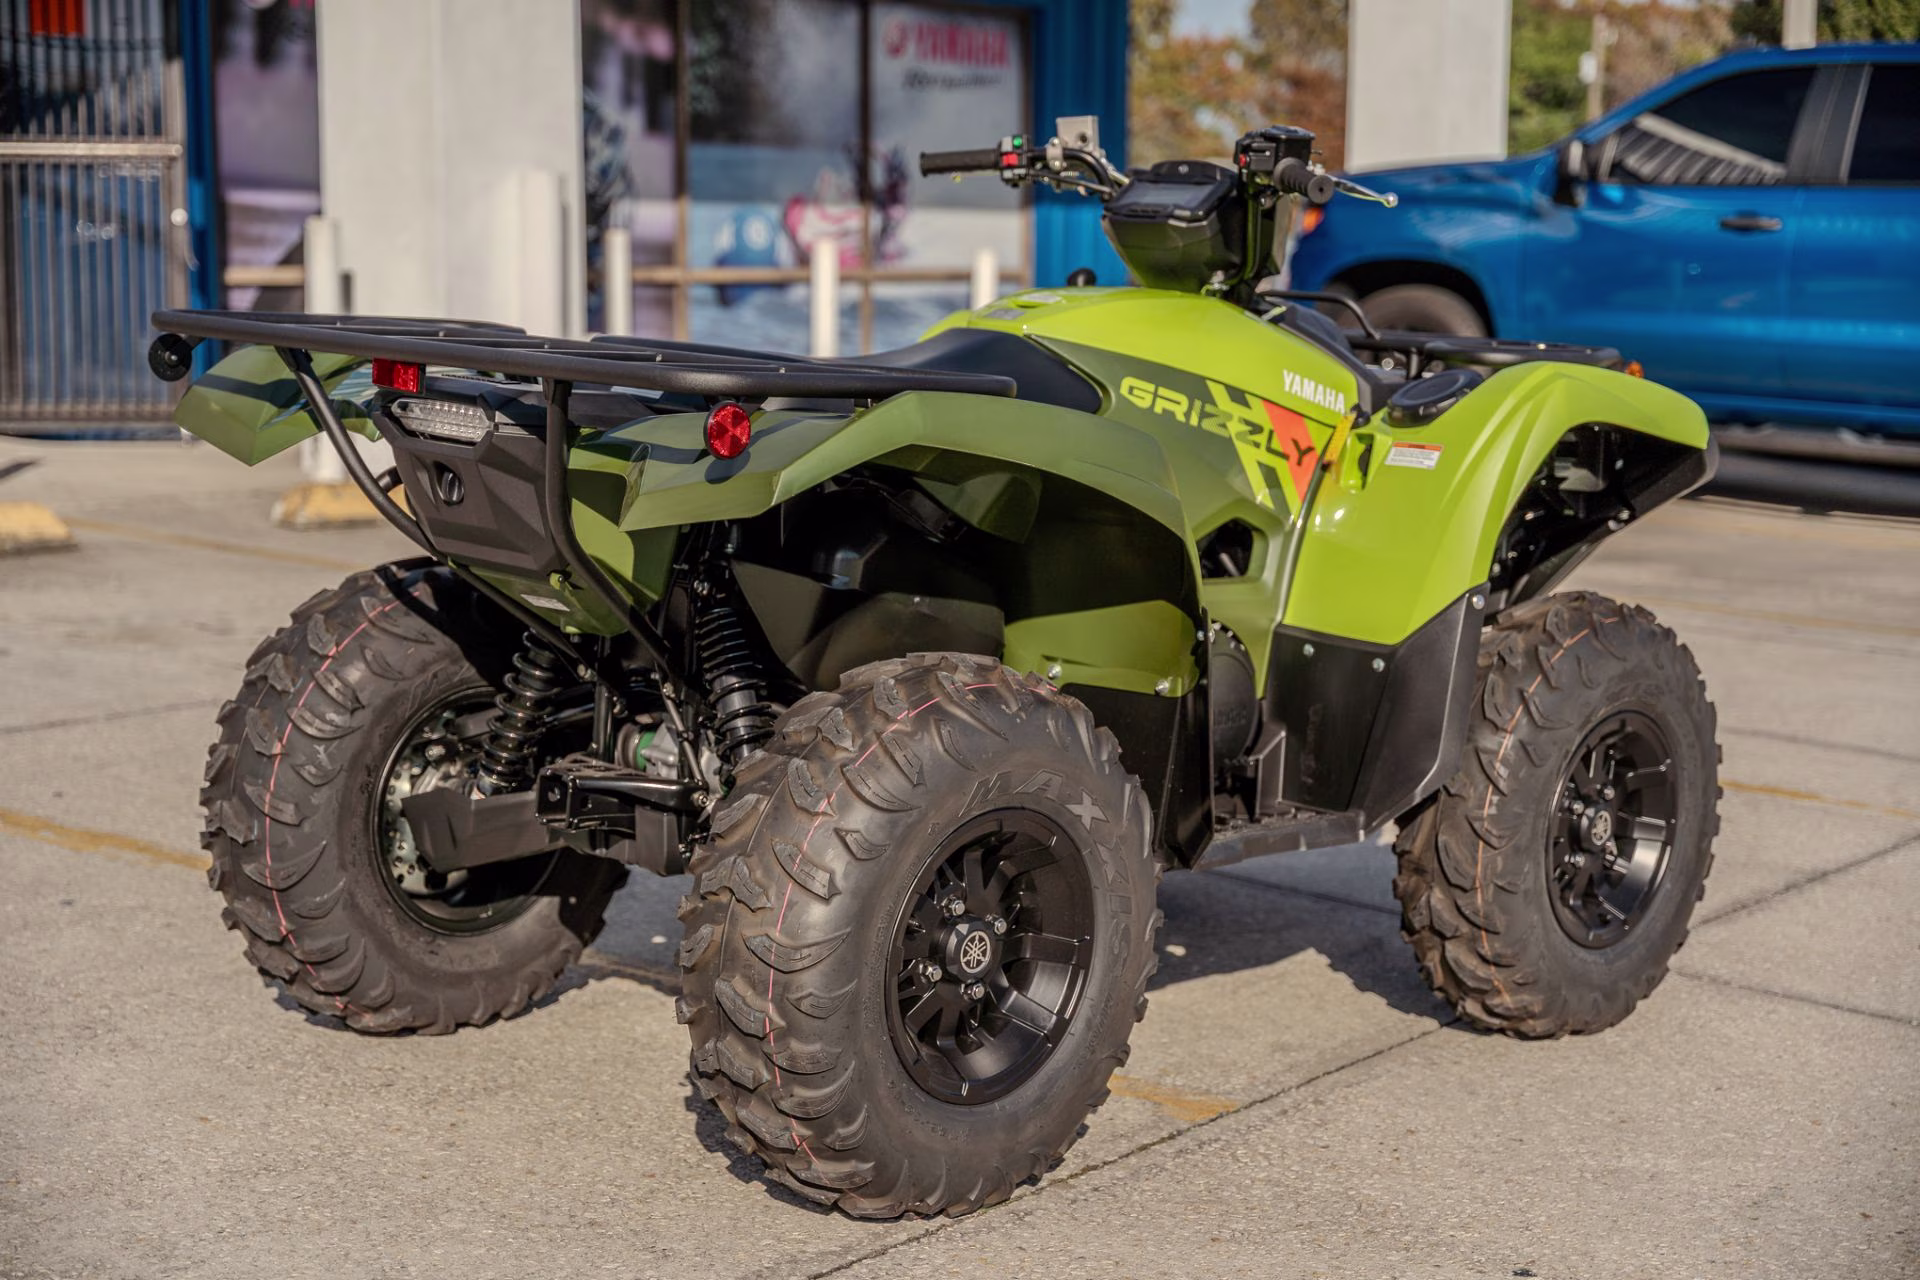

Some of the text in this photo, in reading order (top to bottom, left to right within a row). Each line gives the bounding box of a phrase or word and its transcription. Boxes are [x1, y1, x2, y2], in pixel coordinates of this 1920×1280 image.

[1120, 376, 1315, 466] GRIZZLY
[1283, 369, 1346, 414] YAMAHA
[959, 769, 1131, 978] MAXXIS
